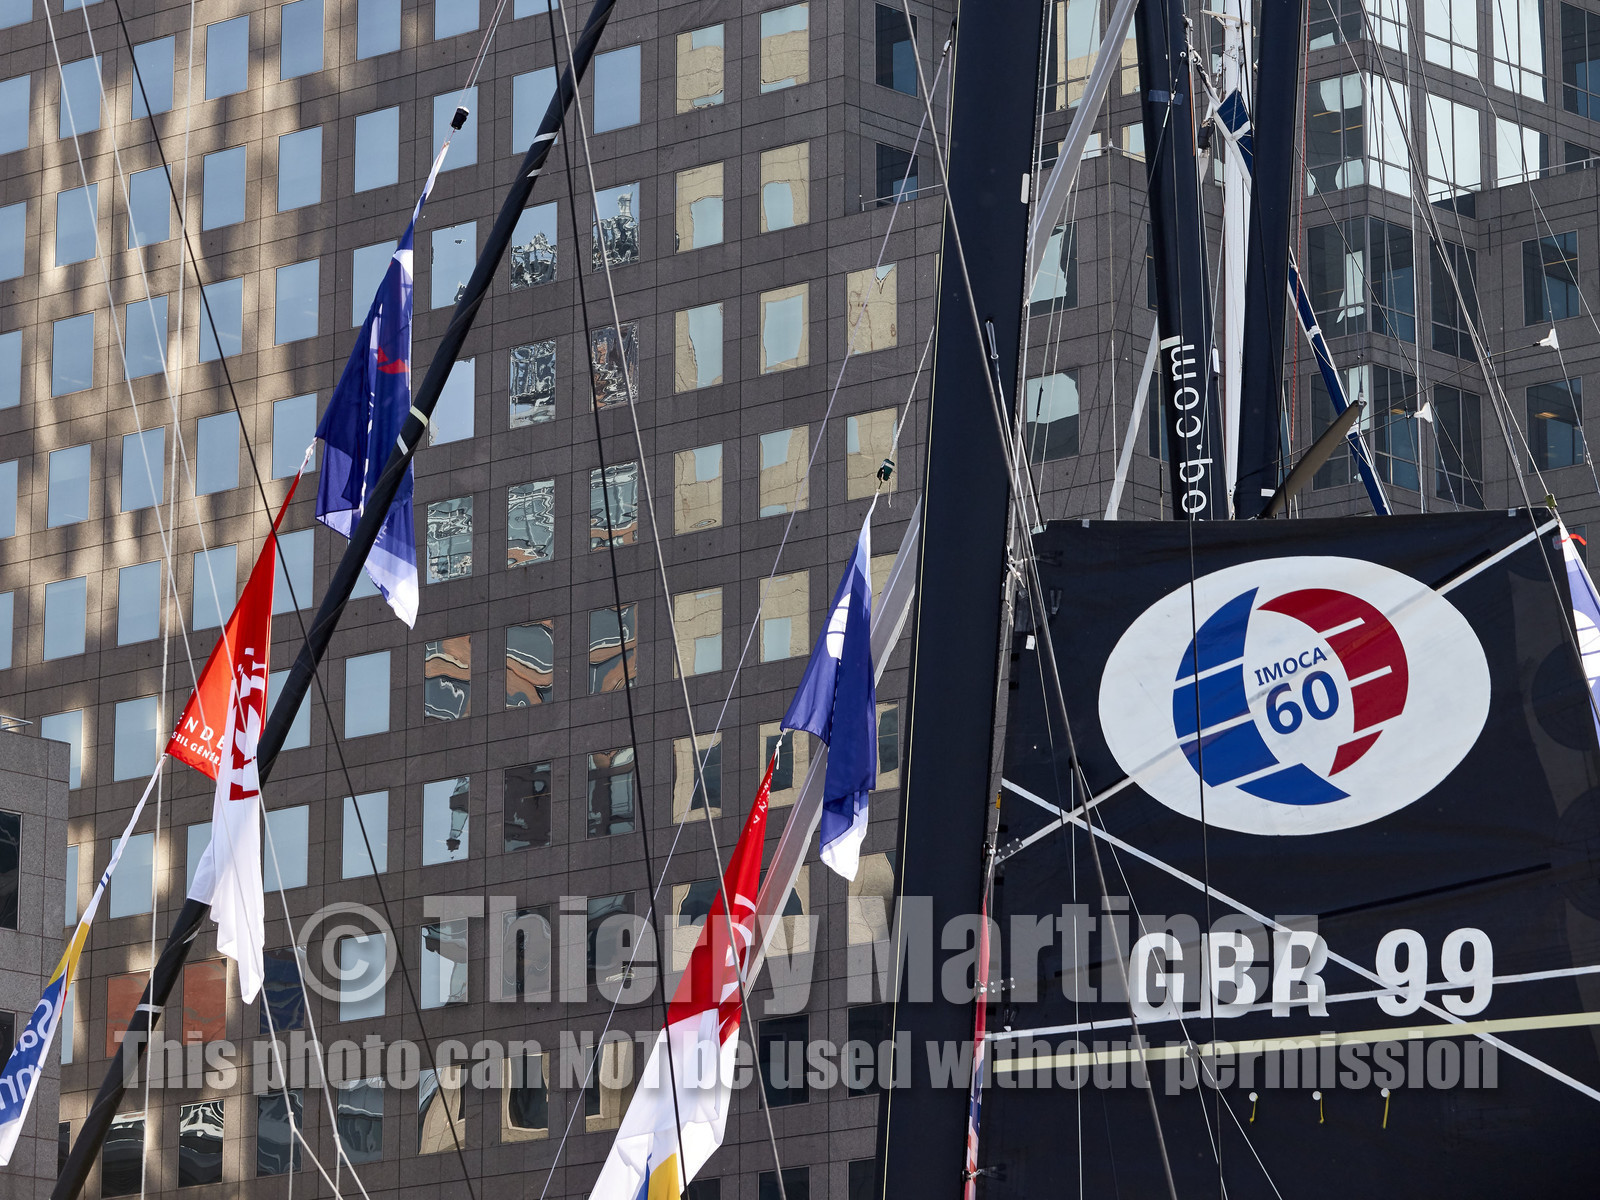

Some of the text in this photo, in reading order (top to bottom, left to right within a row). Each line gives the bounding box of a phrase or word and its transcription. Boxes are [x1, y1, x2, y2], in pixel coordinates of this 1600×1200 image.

[1170, 343, 1213, 520] oq.com
[1254, 647, 1328, 686] IMOCA
[1266, 670, 1339, 734] 60
[1128, 927, 1494, 1019] GBR 99
